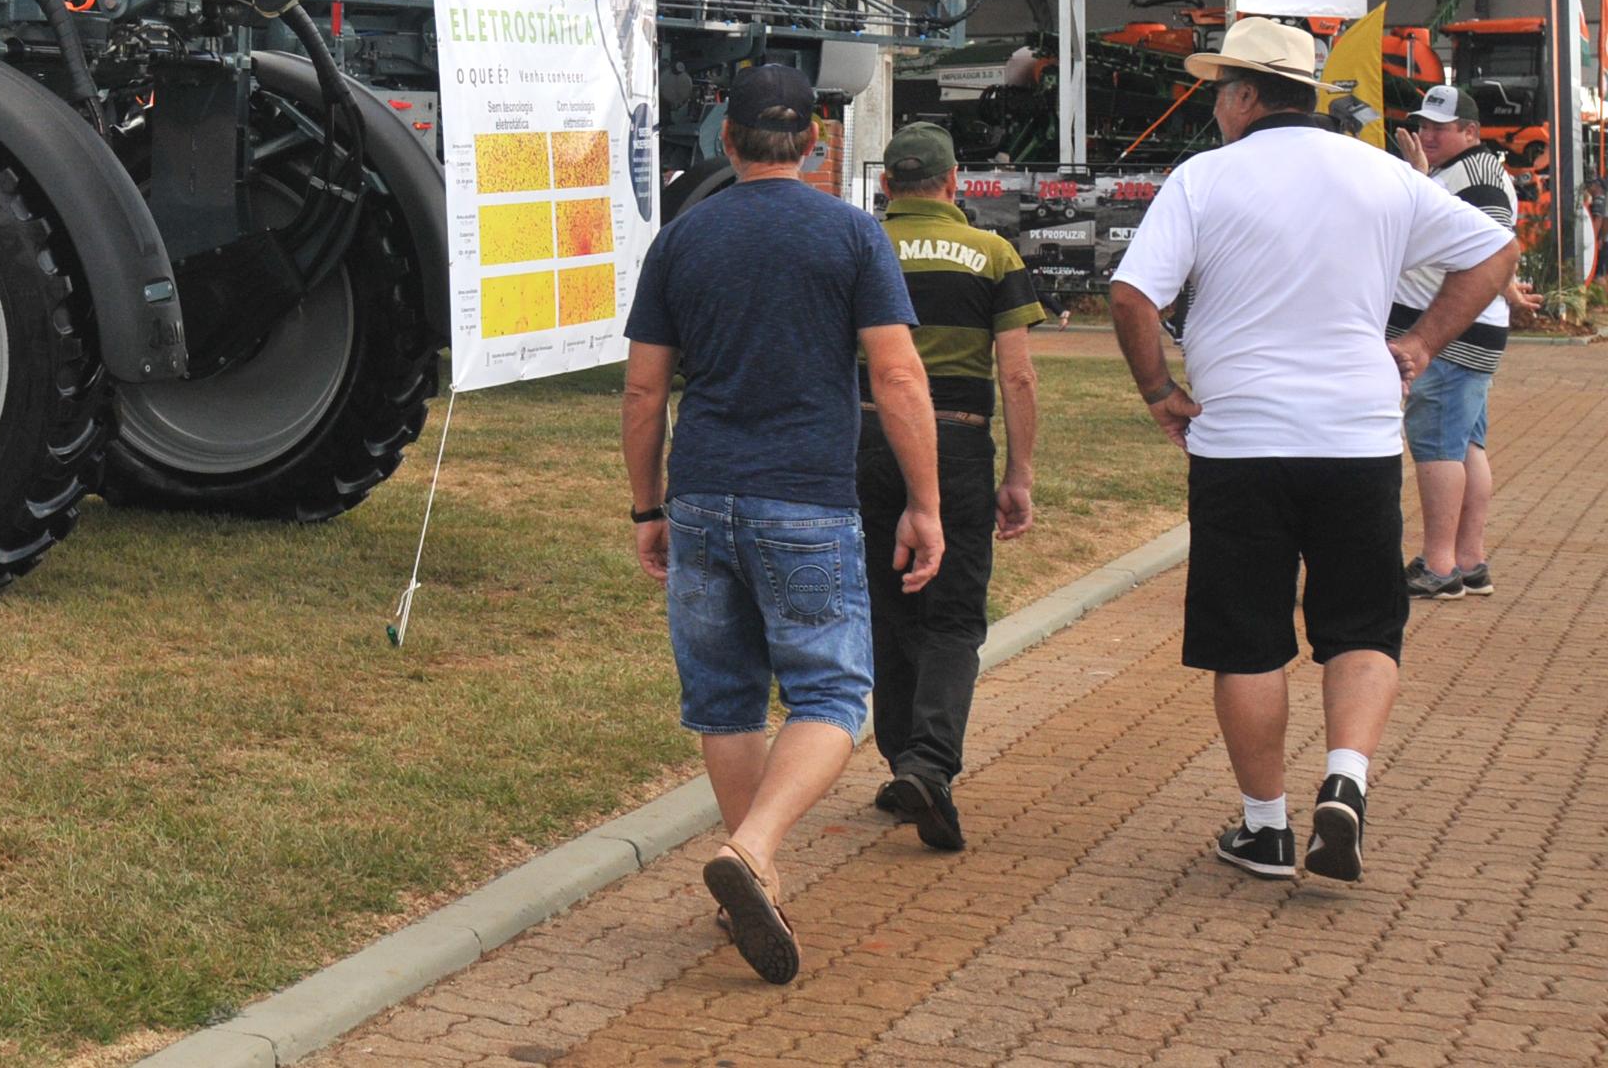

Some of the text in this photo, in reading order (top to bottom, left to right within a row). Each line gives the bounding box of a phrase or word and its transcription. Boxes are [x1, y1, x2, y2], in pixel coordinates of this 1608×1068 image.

[449, 4, 596, 46] ELETROSTÁTICA
[456, 68, 465, 84] O
[469, 68, 494, 87] QUE
[497, 64, 509, 84] É?
[519, 70, 544, 83] Venha
[487, 100, 502, 113] Sem
[964, 180, 1003, 198] 2016
[898, 239, 988, 273] MARINO
